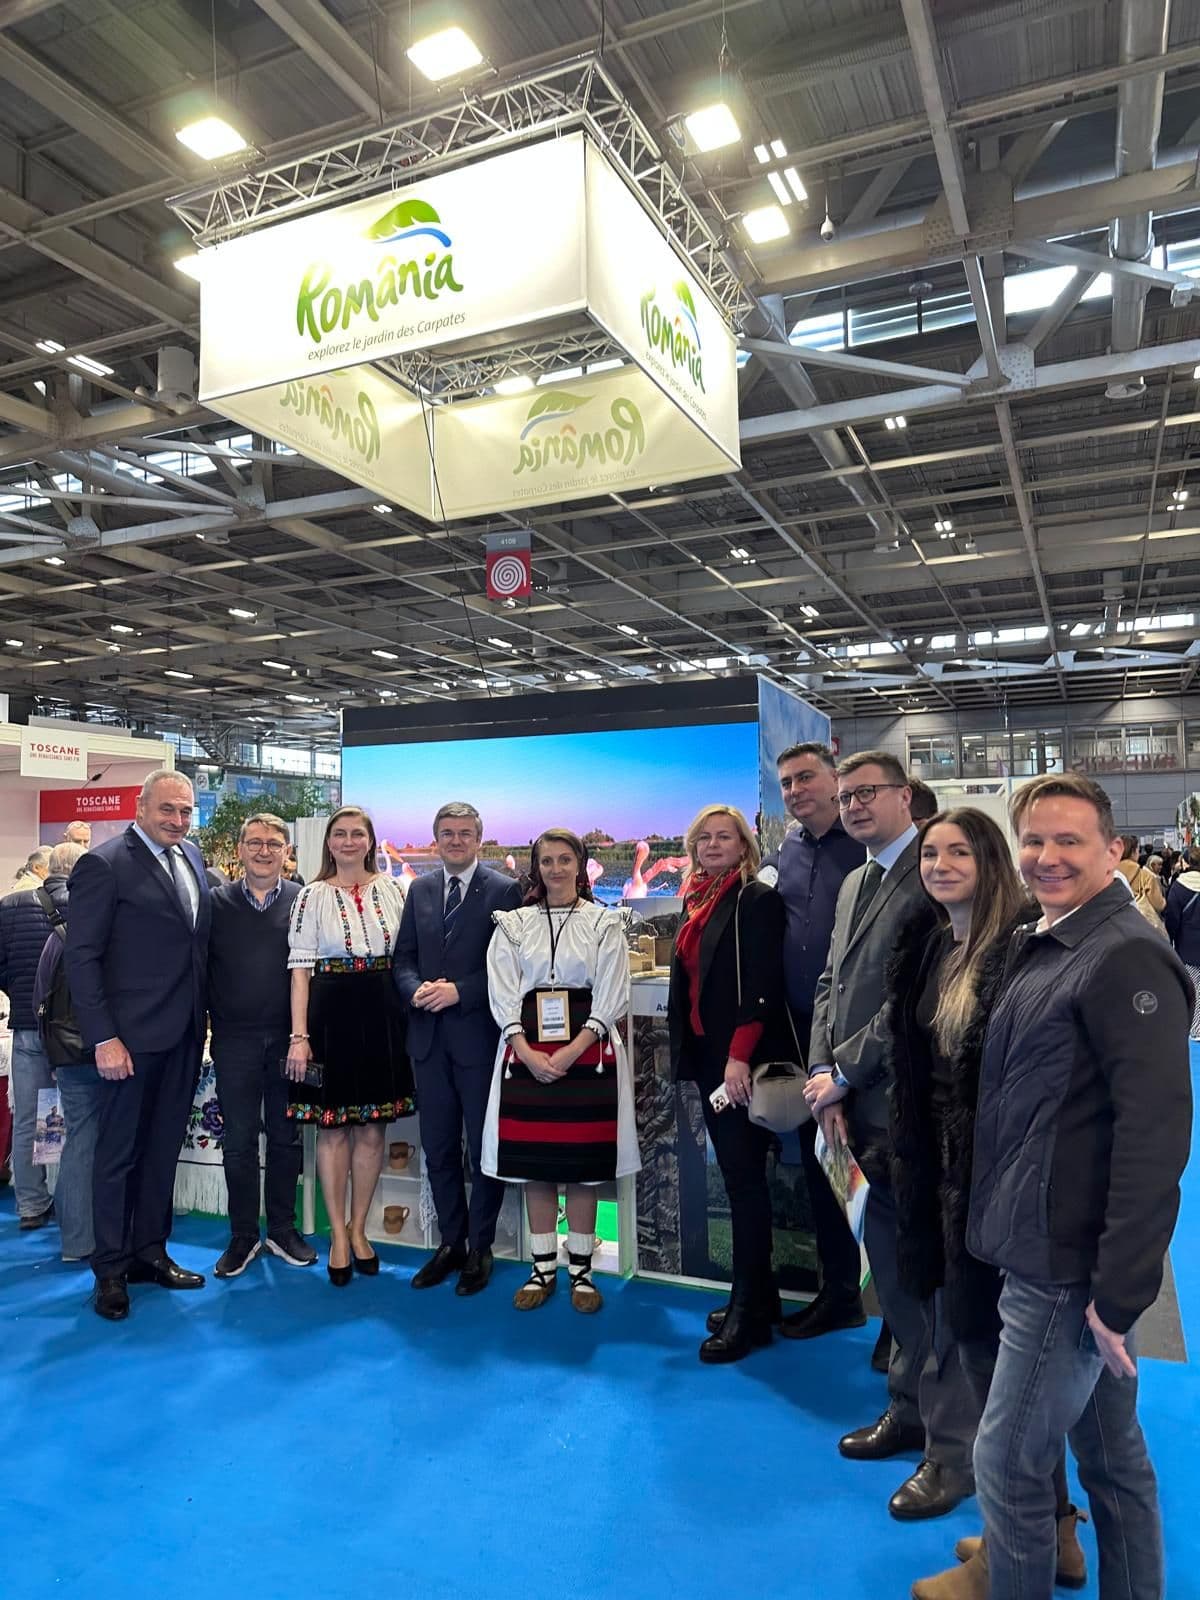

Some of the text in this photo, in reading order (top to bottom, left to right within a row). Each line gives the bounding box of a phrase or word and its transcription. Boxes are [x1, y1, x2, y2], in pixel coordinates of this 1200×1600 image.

[297, 252, 464, 344] România
[308, 312, 466, 361] explorez le jardin des Carpates
[29, 743, 80, 756] TOSCANE
[76, 795, 120, 806] TOSCANE
